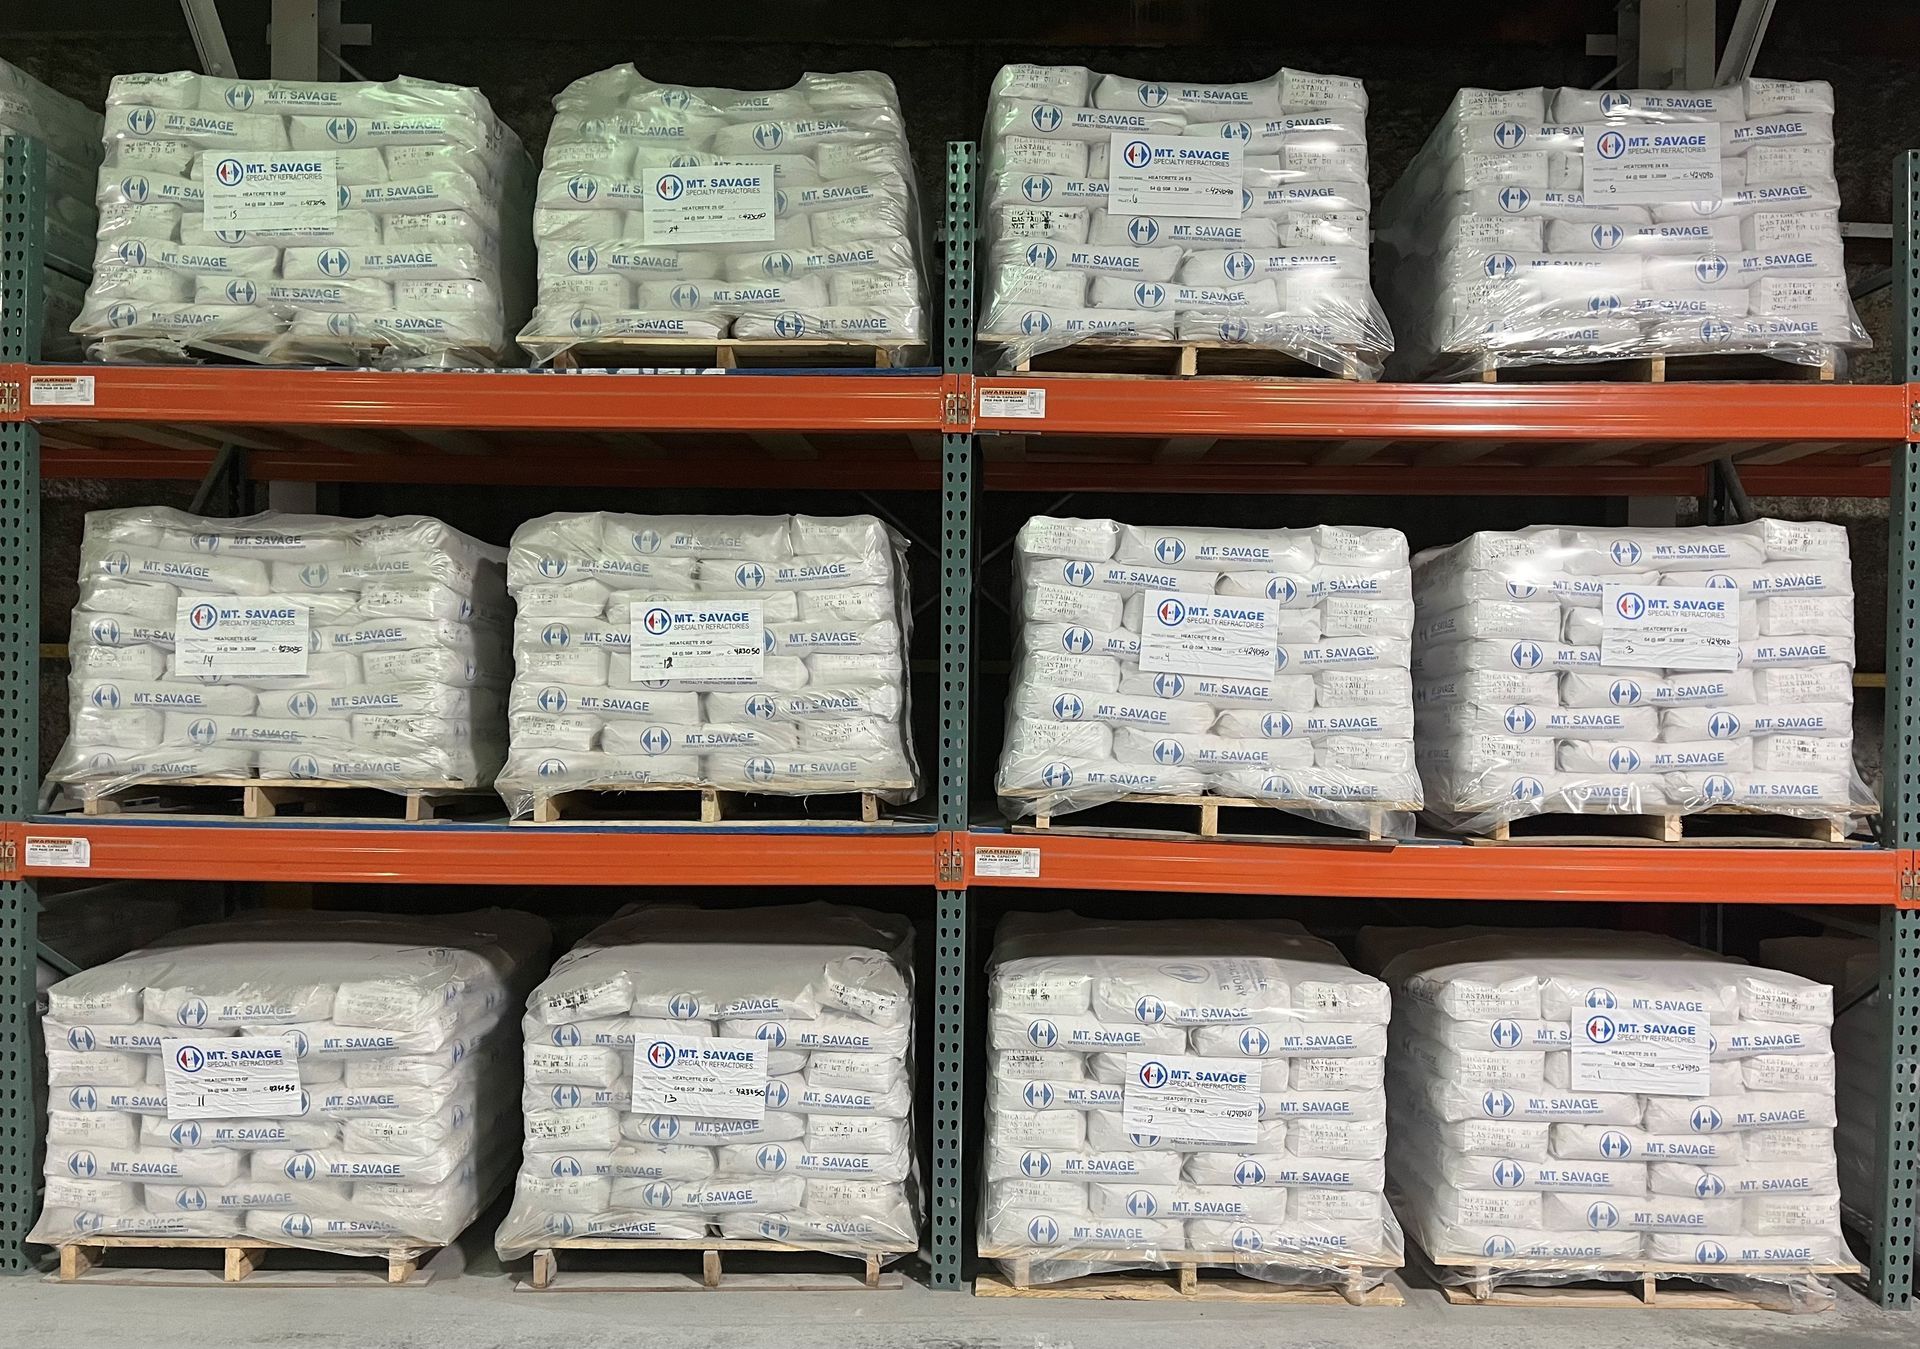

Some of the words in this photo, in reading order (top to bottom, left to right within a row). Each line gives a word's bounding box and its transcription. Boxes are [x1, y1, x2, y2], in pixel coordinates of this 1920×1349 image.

[1182, 90, 1200, 99] MT.
[1203, 90, 1248, 101] SAVAGE
[1645, 98, 1664, 107] MT.
[1667, 98, 1712, 108] SAVAGE
[1629, 138, 1649, 146] MT.
[1655, 136, 1706, 146] SAVAGE
[1155, 149, 1175, 157] MT.
[1180, 150, 1229, 160] SAVAGE
[246, 164, 266, 173] MT.
[271, 163, 322, 172] SAVAGE
[687, 180, 706, 188] MT.
[711, 178, 760, 187] SAVAGE
[366, 188, 386, 199] MT.
[388, 184, 433, 197] SAVAGE
[802, 189, 821, 200] MT.
[822, 185, 869, 198] SAVAGE
[364, 255, 386, 265] MT.
[388, 252, 433, 264] SAVAGE
[1072, 254, 1090, 264] MT.
[1093, 256, 1139, 267] SAVAGE
[714, 291, 732, 300] MT.
[734, 289, 780, 299] SAVAGE
[1200, 547, 1219, 556] MT.
[1222, 547, 1269, 557] SAVAGE
[1656, 545, 1674, 554] MT.
[1678, 544, 1725, 554] SAVAGE
[779, 568, 798, 578] MT.
[800, 564, 845, 576] SAVAGE
[1648, 600, 1669, 609] MT.
[1674, 600, 1725, 610] SAVAGE
[221, 610, 240, 618] MT.
[246, 610, 295, 618] SAVAGE
[675, 614, 695, 623] MT.
[700, 613, 749, 621] SAVAGE
[1189, 607, 1209, 616] MT.
[1214, 608, 1264, 621] SAVAGE
[1187, 617, 1218, 625] SPECIALTY
[1220, 620, 1264, 629] REFRACTORIES
[335, 633, 354, 643] MT.
[356, 628, 402, 641] SAVAGE
[789, 633, 807, 643] MT.
[811, 632, 856, 643] SAVAGE
[1309, 719, 1327, 729] MT.
[1330, 718, 1378, 728] SAVAGE
[1551, 715, 1570, 725] MT.
[1572, 715, 1620, 725] SAVAGE
[1619, 1024, 1639, 1033] MT.
[1644, 1025, 1696, 1035] SAVAGE
[801, 1034, 819, 1045] MT.
[822, 1035, 869, 1046] SAVAGE
[1073, 1030, 1092, 1041] MT.
[1094, 1031, 1140, 1042] SAVAGE
[1284, 1036, 1304, 1046] MT.
[1306, 1035, 1352, 1045] SAVAGE
[1650, 1035, 1696, 1043] REFRACTORIES
[207, 1052, 227, 1060] MT.
[232, 1050, 282, 1059] SAVAGE
[679, 1049, 698, 1058] MT.
[703, 1051, 753, 1061] SAVAGE
[1171, 1070, 1191, 1079] MT.
[1196, 1072, 1247, 1083] SAVAGE
[1200, 1083, 1246, 1091] REFRACTORIES
[664, 1094, 677, 1103] 13
[803, 1094, 821, 1103] MT.
[824, 1095, 871, 1106] SAVAGE
[1647, 1144, 1666, 1154] MT.
[1668, 1145, 1715, 1155] SAVAGE
[331, 1164, 350, 1174] MT.
[352, 1164, 400, 1174] SAVAGE
[1540, 1171, 1559, 1181] MT.
[1562, 1172, 1609, 1183] SAVAGE
